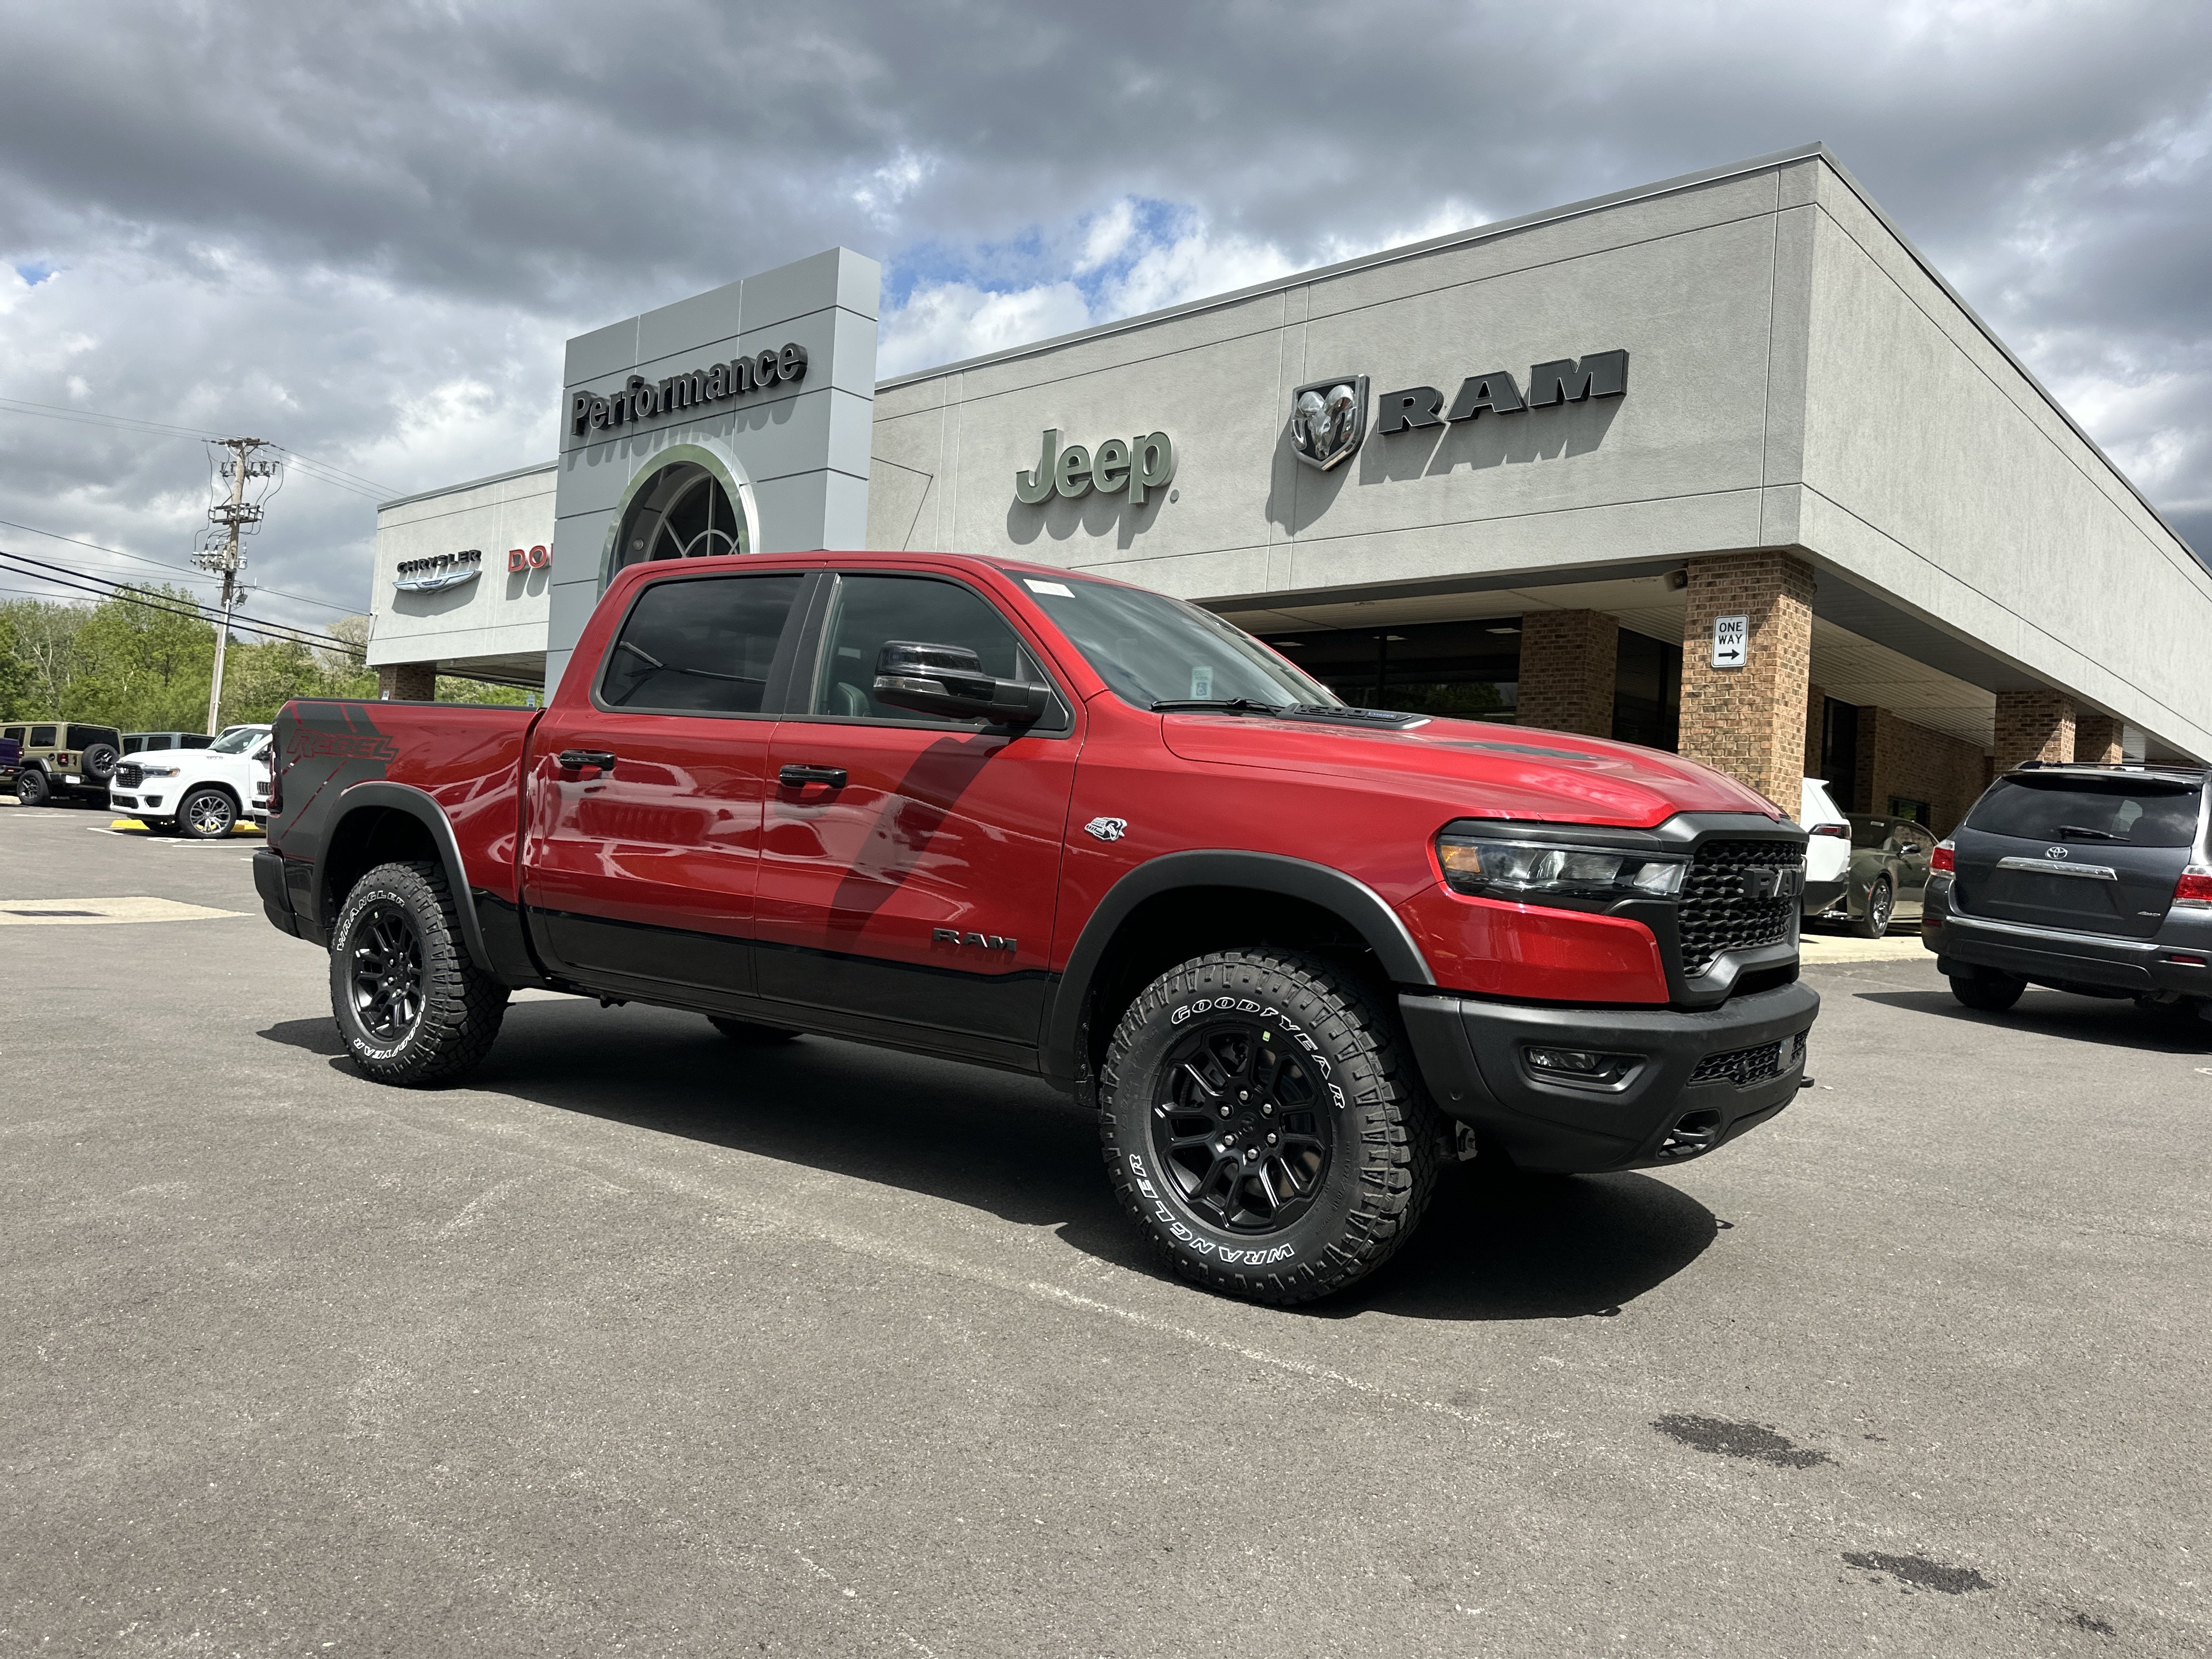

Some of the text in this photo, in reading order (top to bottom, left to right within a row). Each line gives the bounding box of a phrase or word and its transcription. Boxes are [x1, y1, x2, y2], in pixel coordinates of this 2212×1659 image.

[571, 342, 808, 436] Performance
[1377, 349, 1629, 436] RAM
[1015, 428, 1177, 505] Jeep
[397, 549, 482, 573] CHRYSLER
[508, 543, 554, 572] DO
[1718, 634, 1742, 645] WAY
[1719, 622, 1742, 632] ONE
[286, 729, 399, 762] REBEL
[337, 890, 405, 951] WRANGLER
[933, 928, 1017, 952] RAM
[353, 995, 426, 1059] GOODYEAR
[1171, 996, 1345, 1109] GOODYEAR
[1129, 1154, 1295, 1265] WRANGLER
